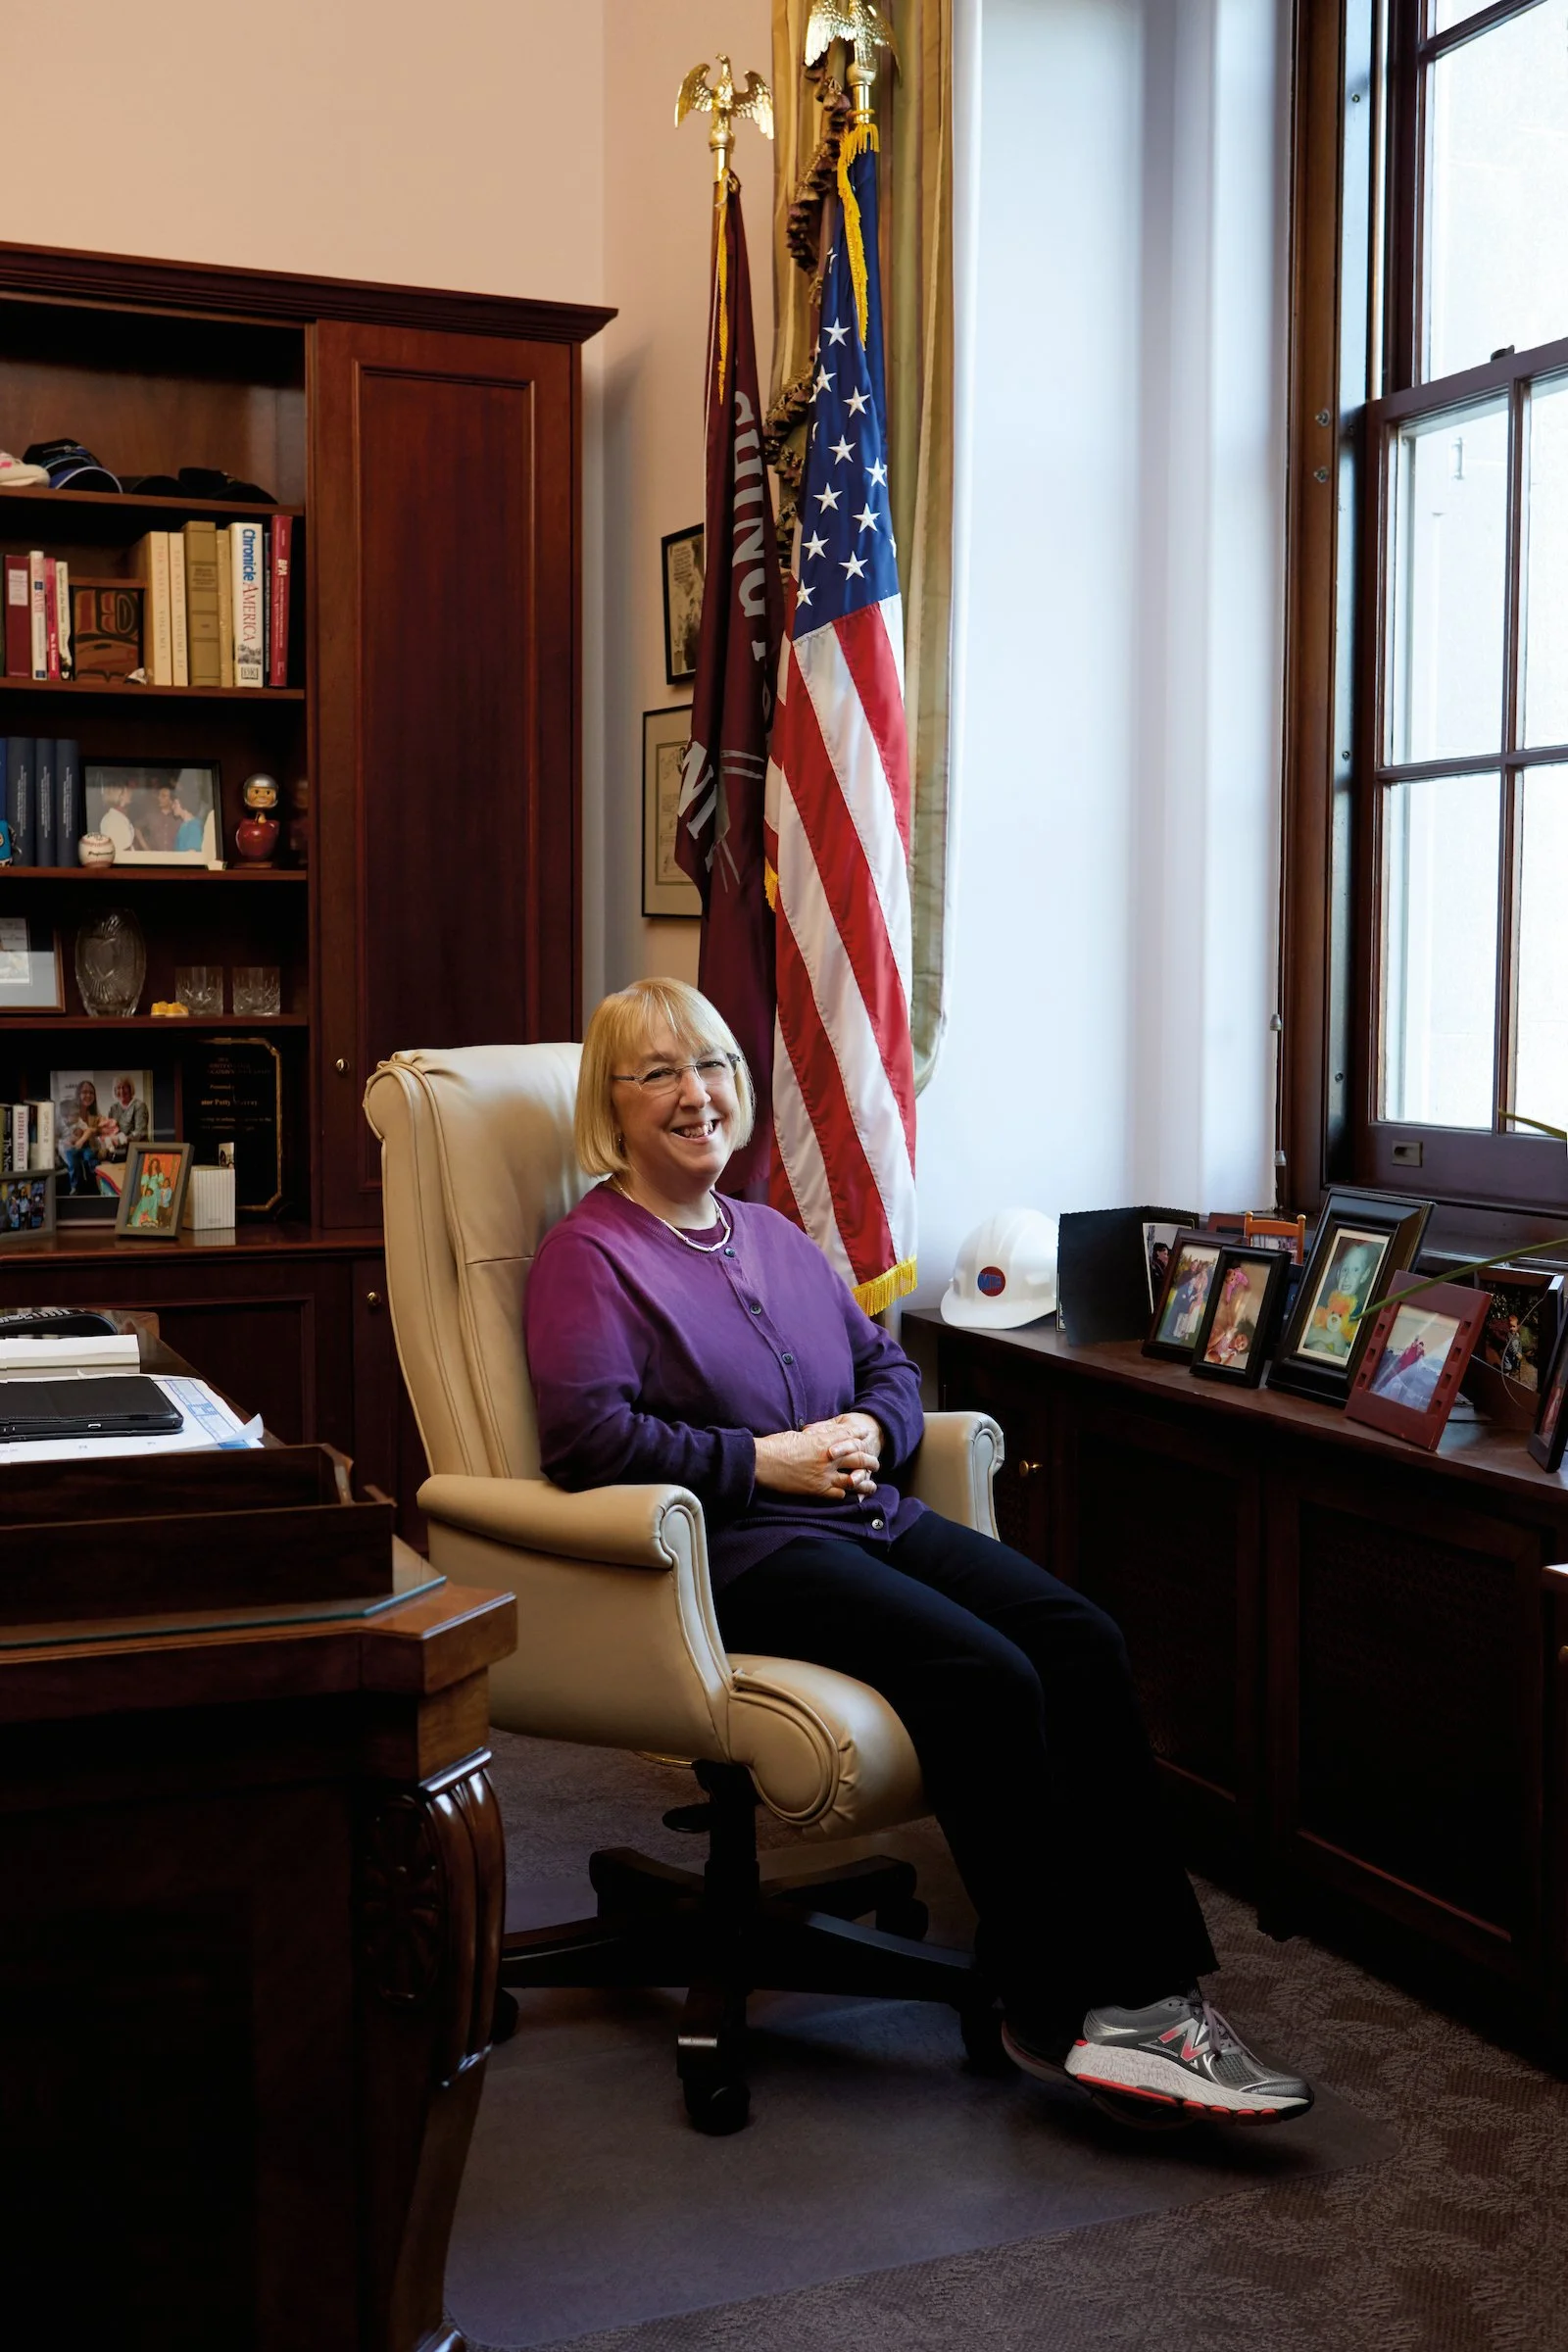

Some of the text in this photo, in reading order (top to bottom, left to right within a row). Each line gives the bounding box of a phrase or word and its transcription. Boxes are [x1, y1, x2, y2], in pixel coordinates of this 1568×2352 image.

[242, 528, 259, 642] Chronicle AMERICA
[277, 559, 288, 575] BPA
